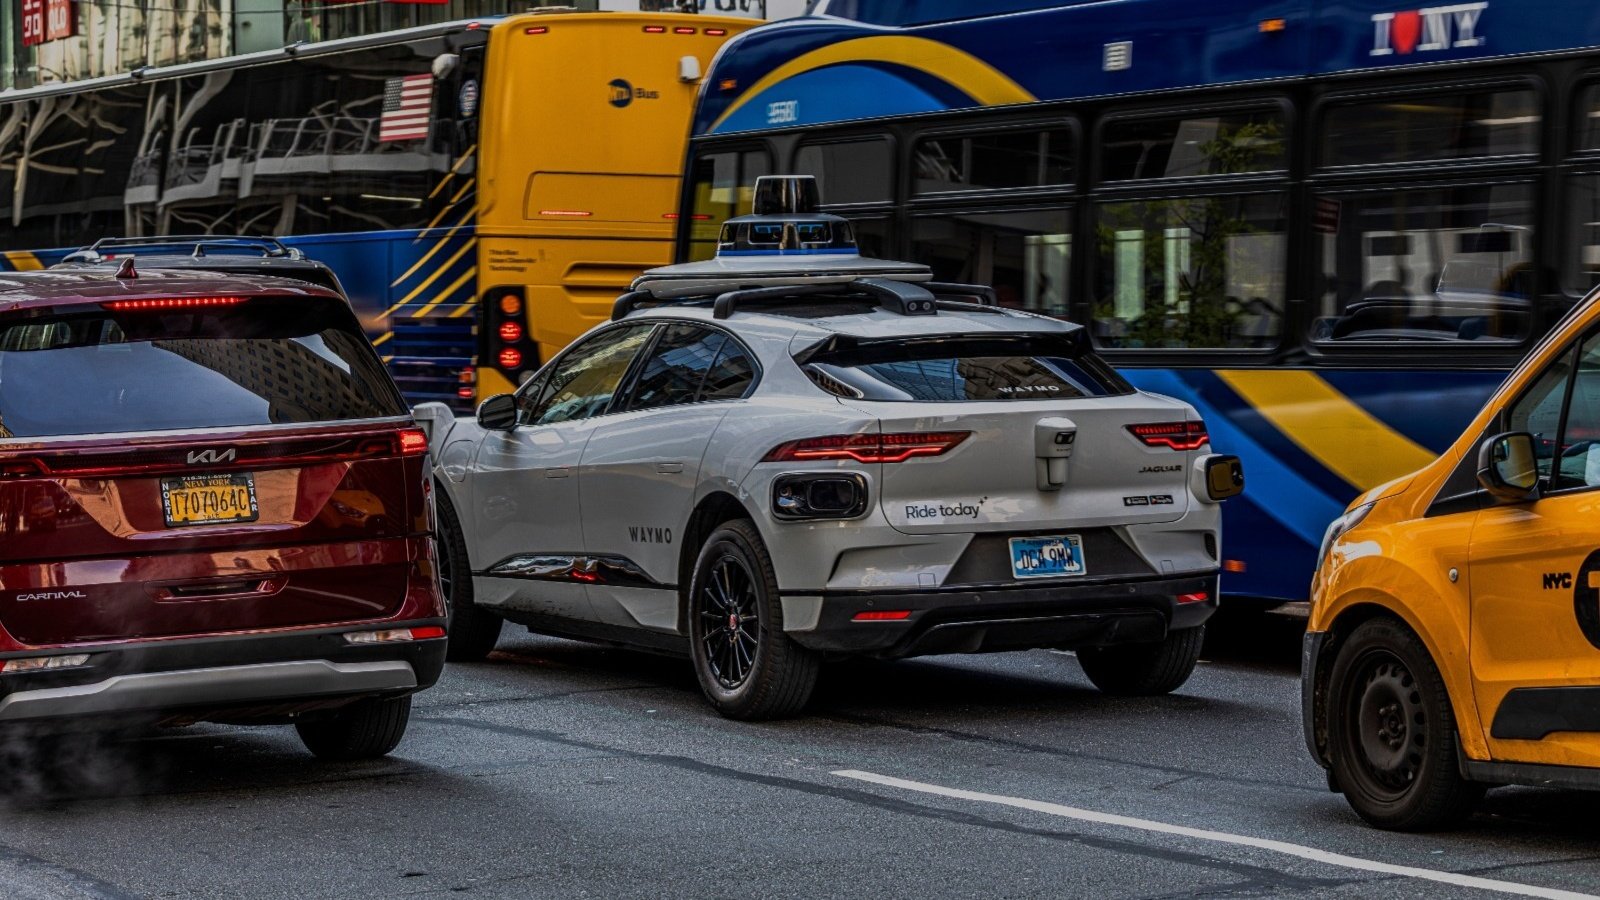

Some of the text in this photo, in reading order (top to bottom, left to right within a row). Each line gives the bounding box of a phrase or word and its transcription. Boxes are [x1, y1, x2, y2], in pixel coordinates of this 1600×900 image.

[998, 385, 1060, 393] WAYMO
[187, 448, 236, 464] KIA
[1138, 465, 1182, 473] JAGUAR
[184, 478, 231, 488] NEW YORK
[162, 483, 174, 522] NORTH
[172, 488, 246, 515] T707064C
[248, 480, 258, 511] STAR
[905, 502, 979, 519] Ride today
[628, 526, 672, 544] WAYMO
[1543, 572, 1572, 590] NYC
[16, 590, 87, 601] CARNIVAL
